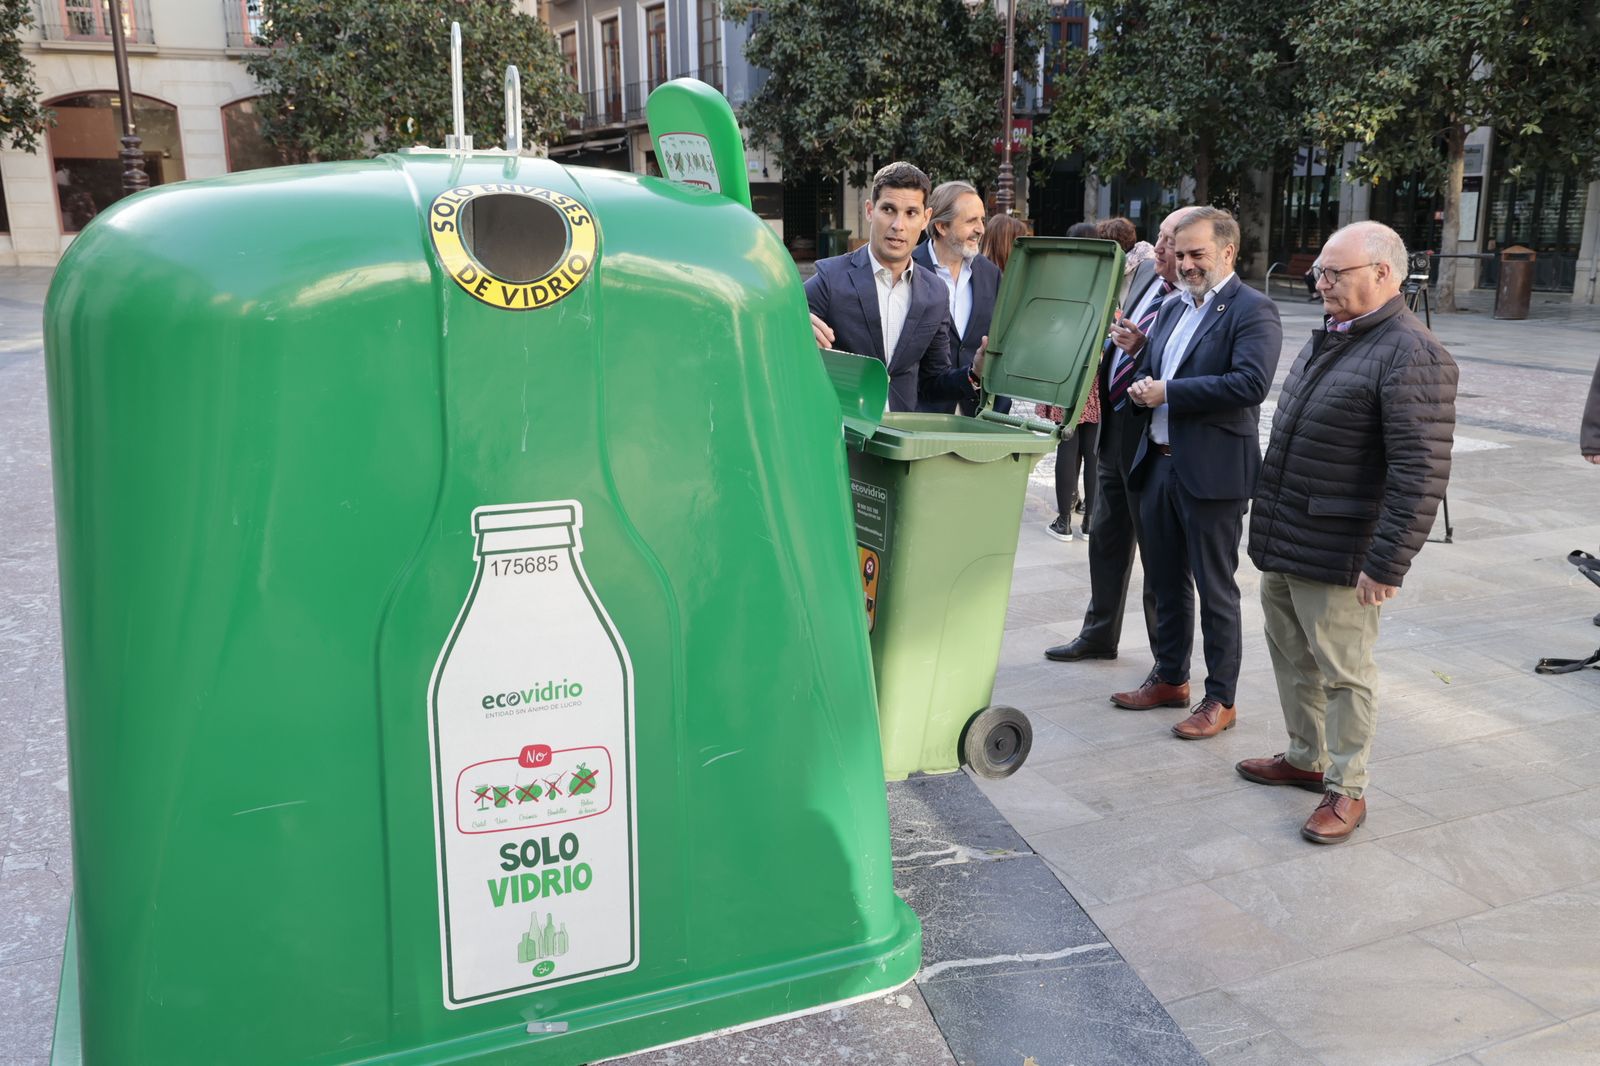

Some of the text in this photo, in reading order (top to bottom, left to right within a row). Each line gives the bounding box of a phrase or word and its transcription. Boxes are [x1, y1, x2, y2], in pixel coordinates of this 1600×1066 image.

[433, 184, 590, 232] SOLO ENVASES
[456, 254, 588, 307] DE VIDRIO
[490, 555, 558, 576] 175685
[481, 678, 583, 710] ecovidrio
[485, 709, 515, 719] ENTIDAD
[515, 707, 527, 715] SIN
[560, 700, 583, 709] LUCRO
[500, 832, 579, 872] SOLO
[487, 862, 593, 908] VIDRIO
